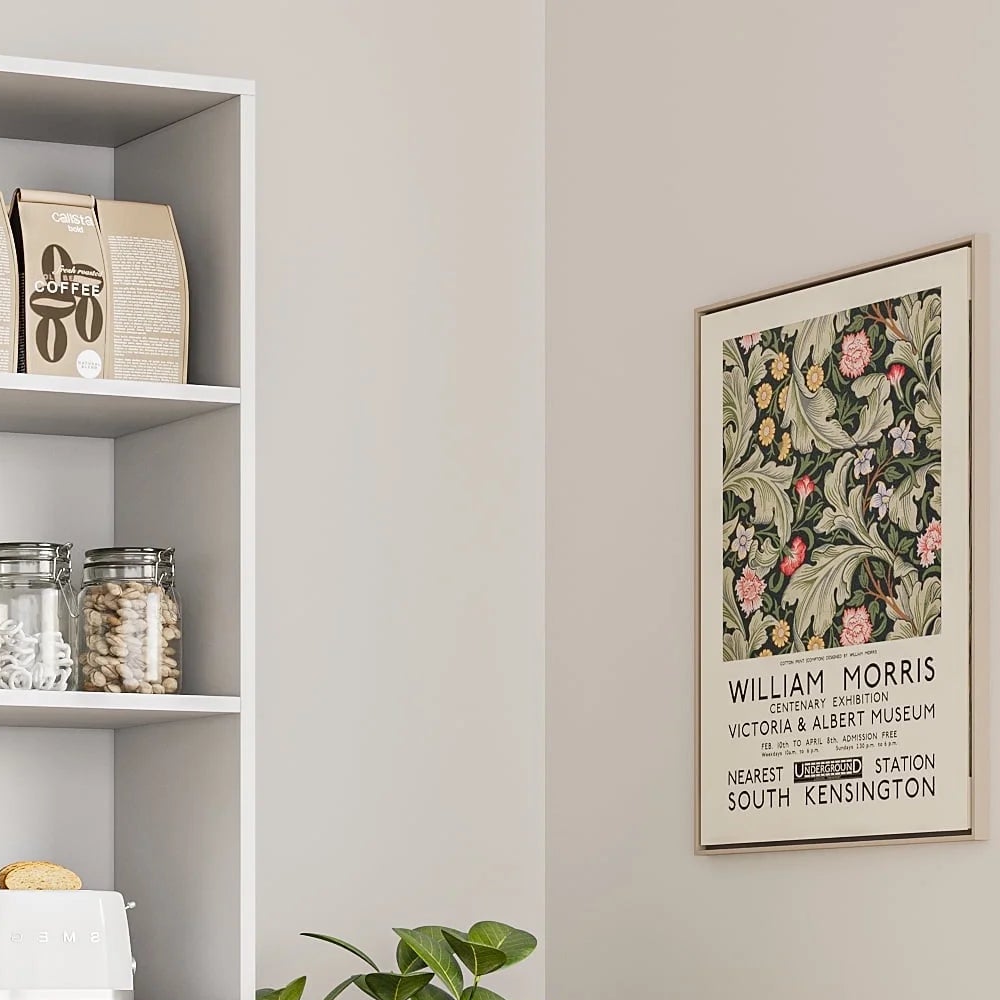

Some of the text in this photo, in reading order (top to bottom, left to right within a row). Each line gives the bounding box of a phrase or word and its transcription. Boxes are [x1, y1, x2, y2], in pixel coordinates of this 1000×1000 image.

[35, 280, 100, 297] COFFEE
[728, 656, 935, 703] WILLIAM MORRIS
[769, 691, 889, 714] CENTENARY EXHIBITION
[728, 703, 935, 738] VICTORIA & ALBERT MUSEUM
[793, 739, 802, 747] TO
[805, 737, 823, 746] APRIL
[842, 732, 878, 742] ADMISSION
[881, 730, 898, 738] FREE
[728, 753, 935, 785] NEAREST UNDERGROUND STATION
[728, 776, 935, 811] SOUTH KENSINGTON
